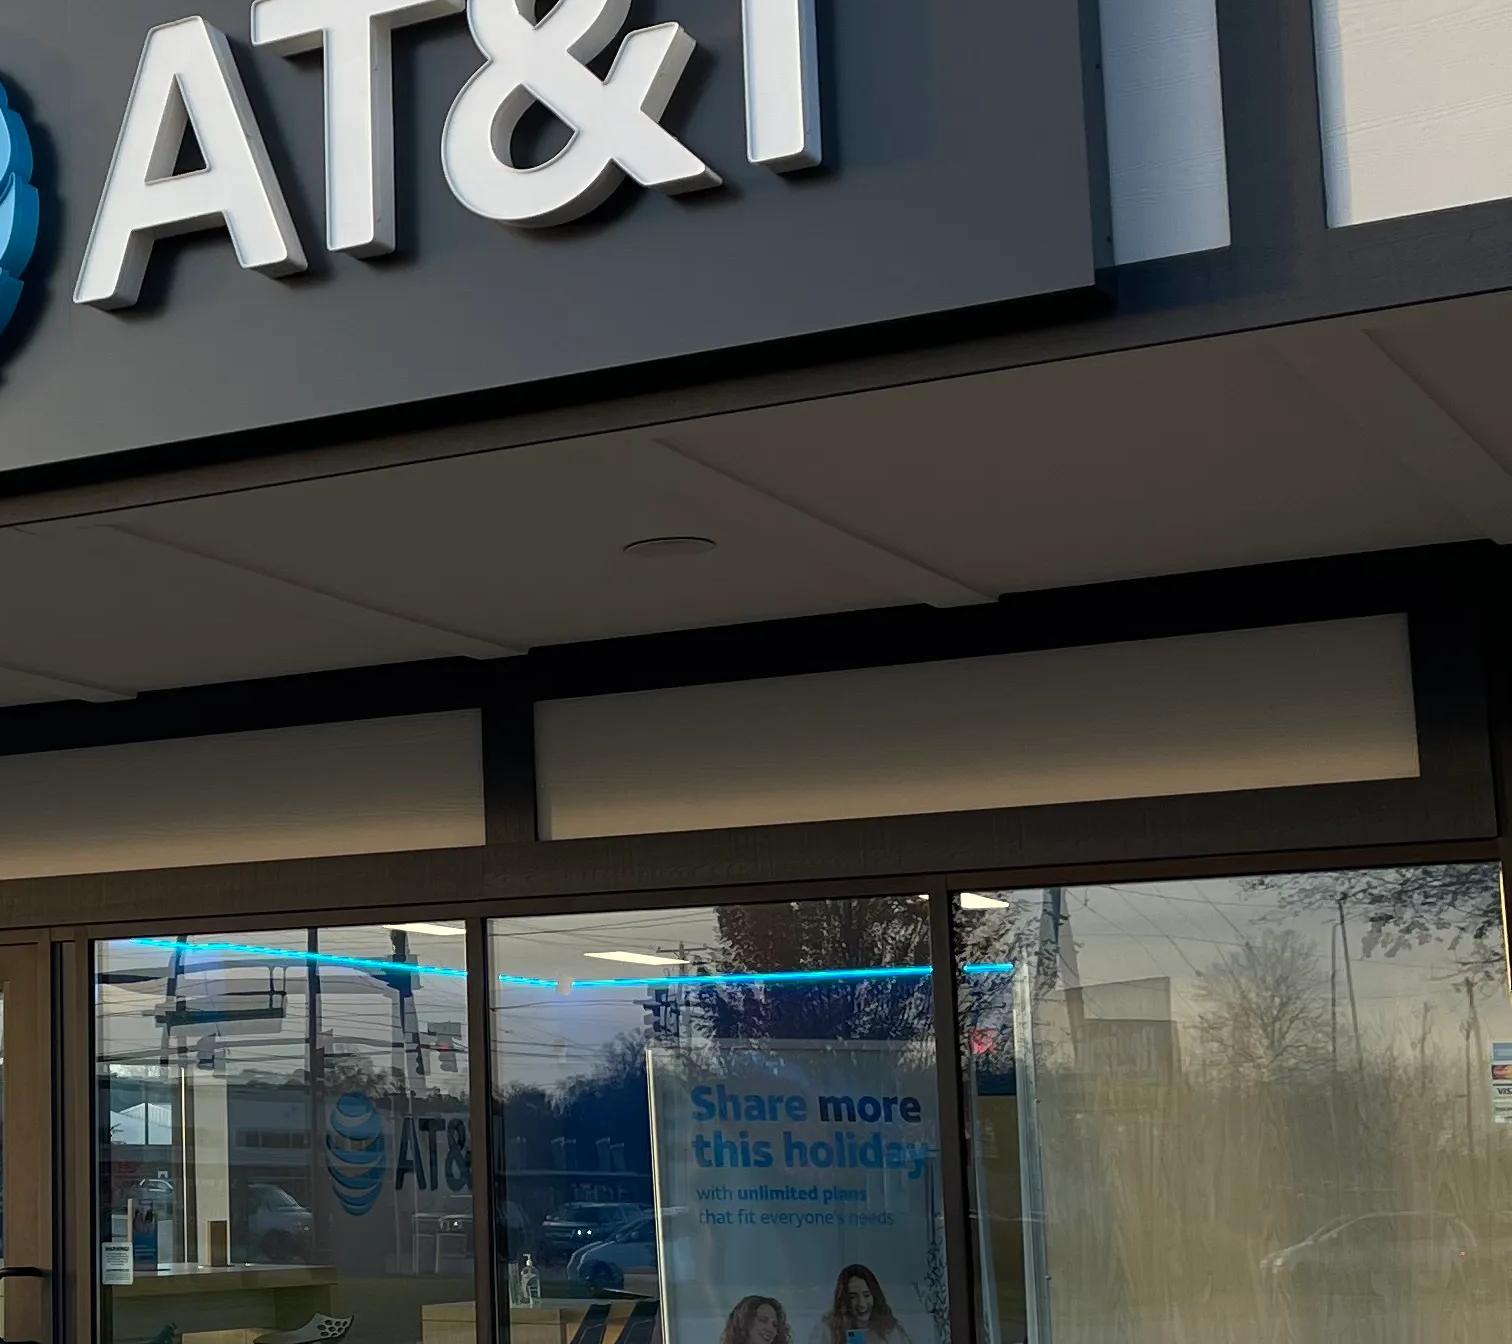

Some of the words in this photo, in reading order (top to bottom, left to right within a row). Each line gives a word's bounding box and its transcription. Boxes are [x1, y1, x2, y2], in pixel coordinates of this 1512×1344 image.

[690, 1084, 808, 1122] Share
[818, 1095, 922, 1123] more
[395, 1118, 472, 1192] AT&
[691, 1130, 774, 1168] this
[783, 1131, 930, 1179] holiday
[697, 1185, 733, 1201] with
[737, 1185, 818, 1201] unlimited
[823, 1185, 867, 1204] plans
[699, 1210, 732, 1224] that
[738, 1209, 756, 1224] fit
[761, 1210, 844, 1228] everyone's
[849, 1210, 894, 1225] needs
